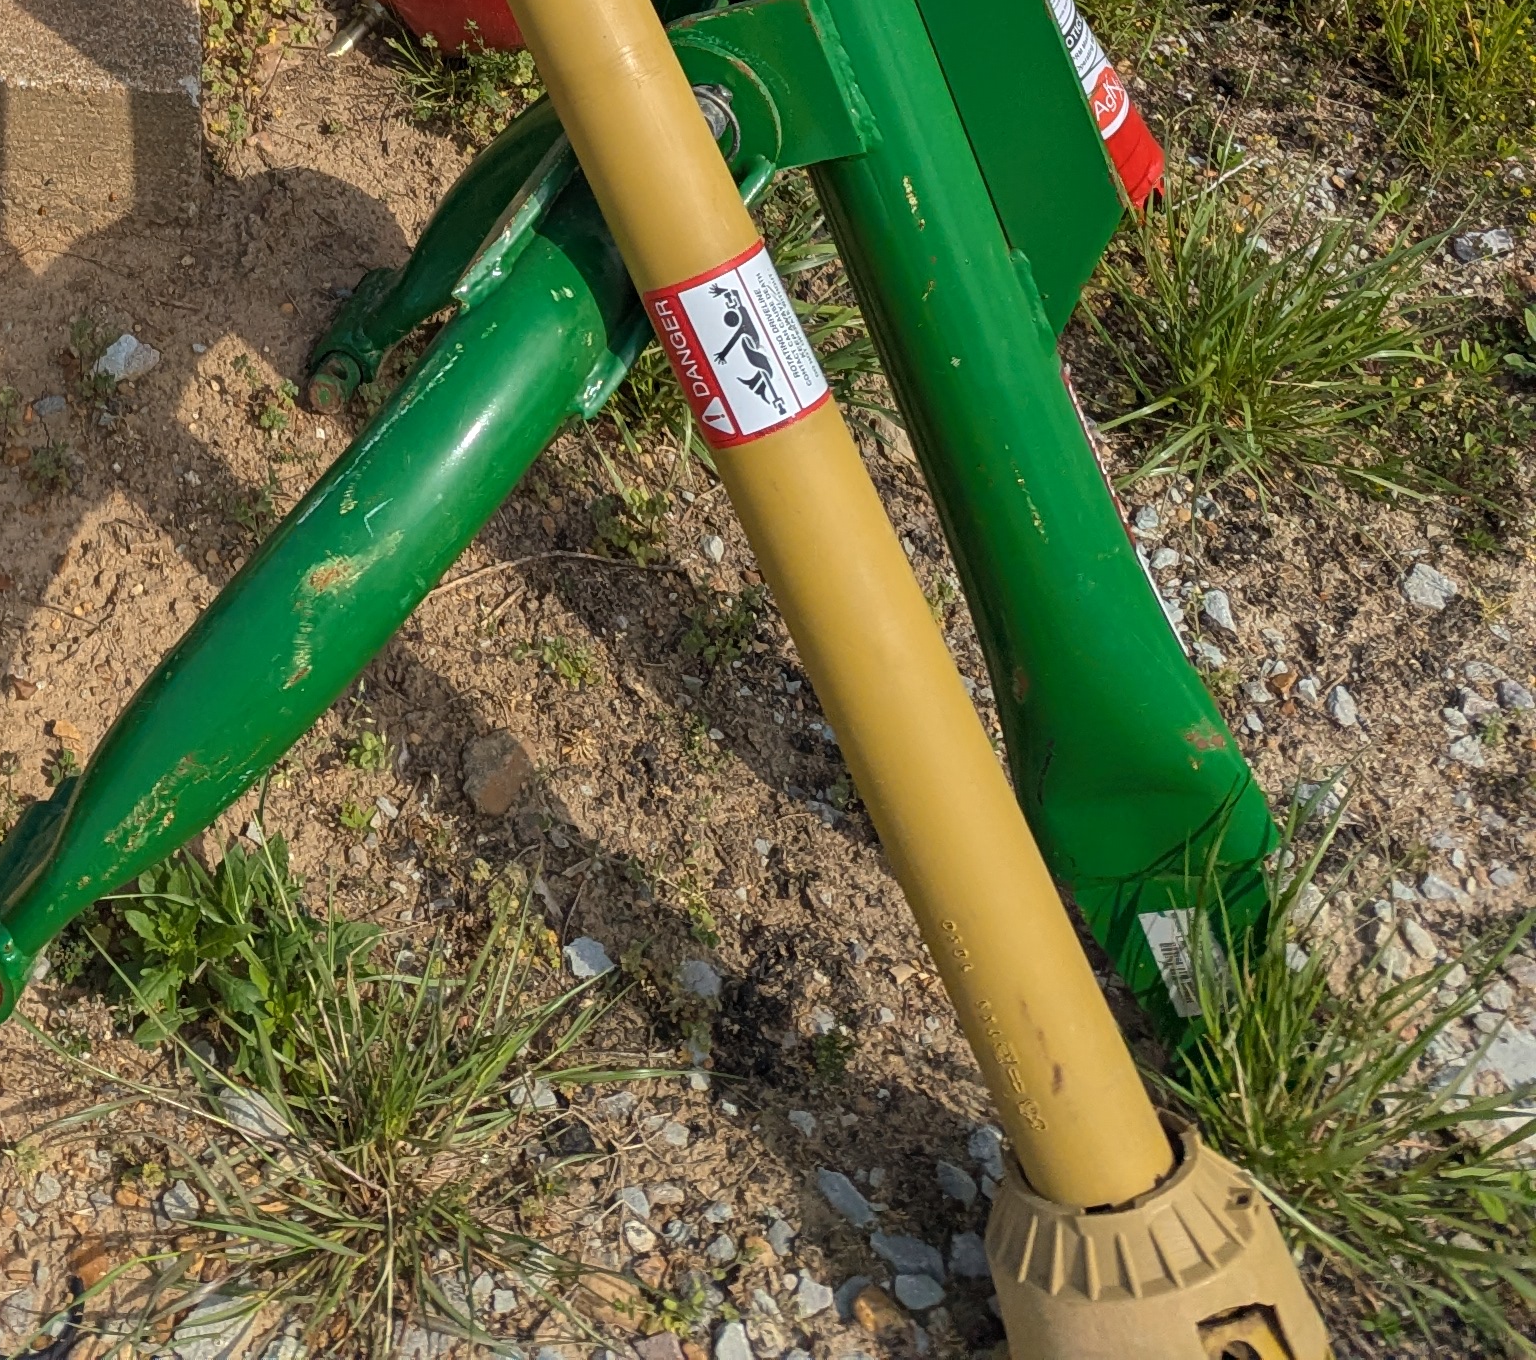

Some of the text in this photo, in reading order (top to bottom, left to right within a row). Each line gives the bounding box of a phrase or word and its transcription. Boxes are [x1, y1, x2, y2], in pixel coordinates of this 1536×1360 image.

[753, 272, 773, 300] DEATH
[654, 299, 711, 398] DANGER
[751, 287, 802, 379] ROTATING DRIVELINE
